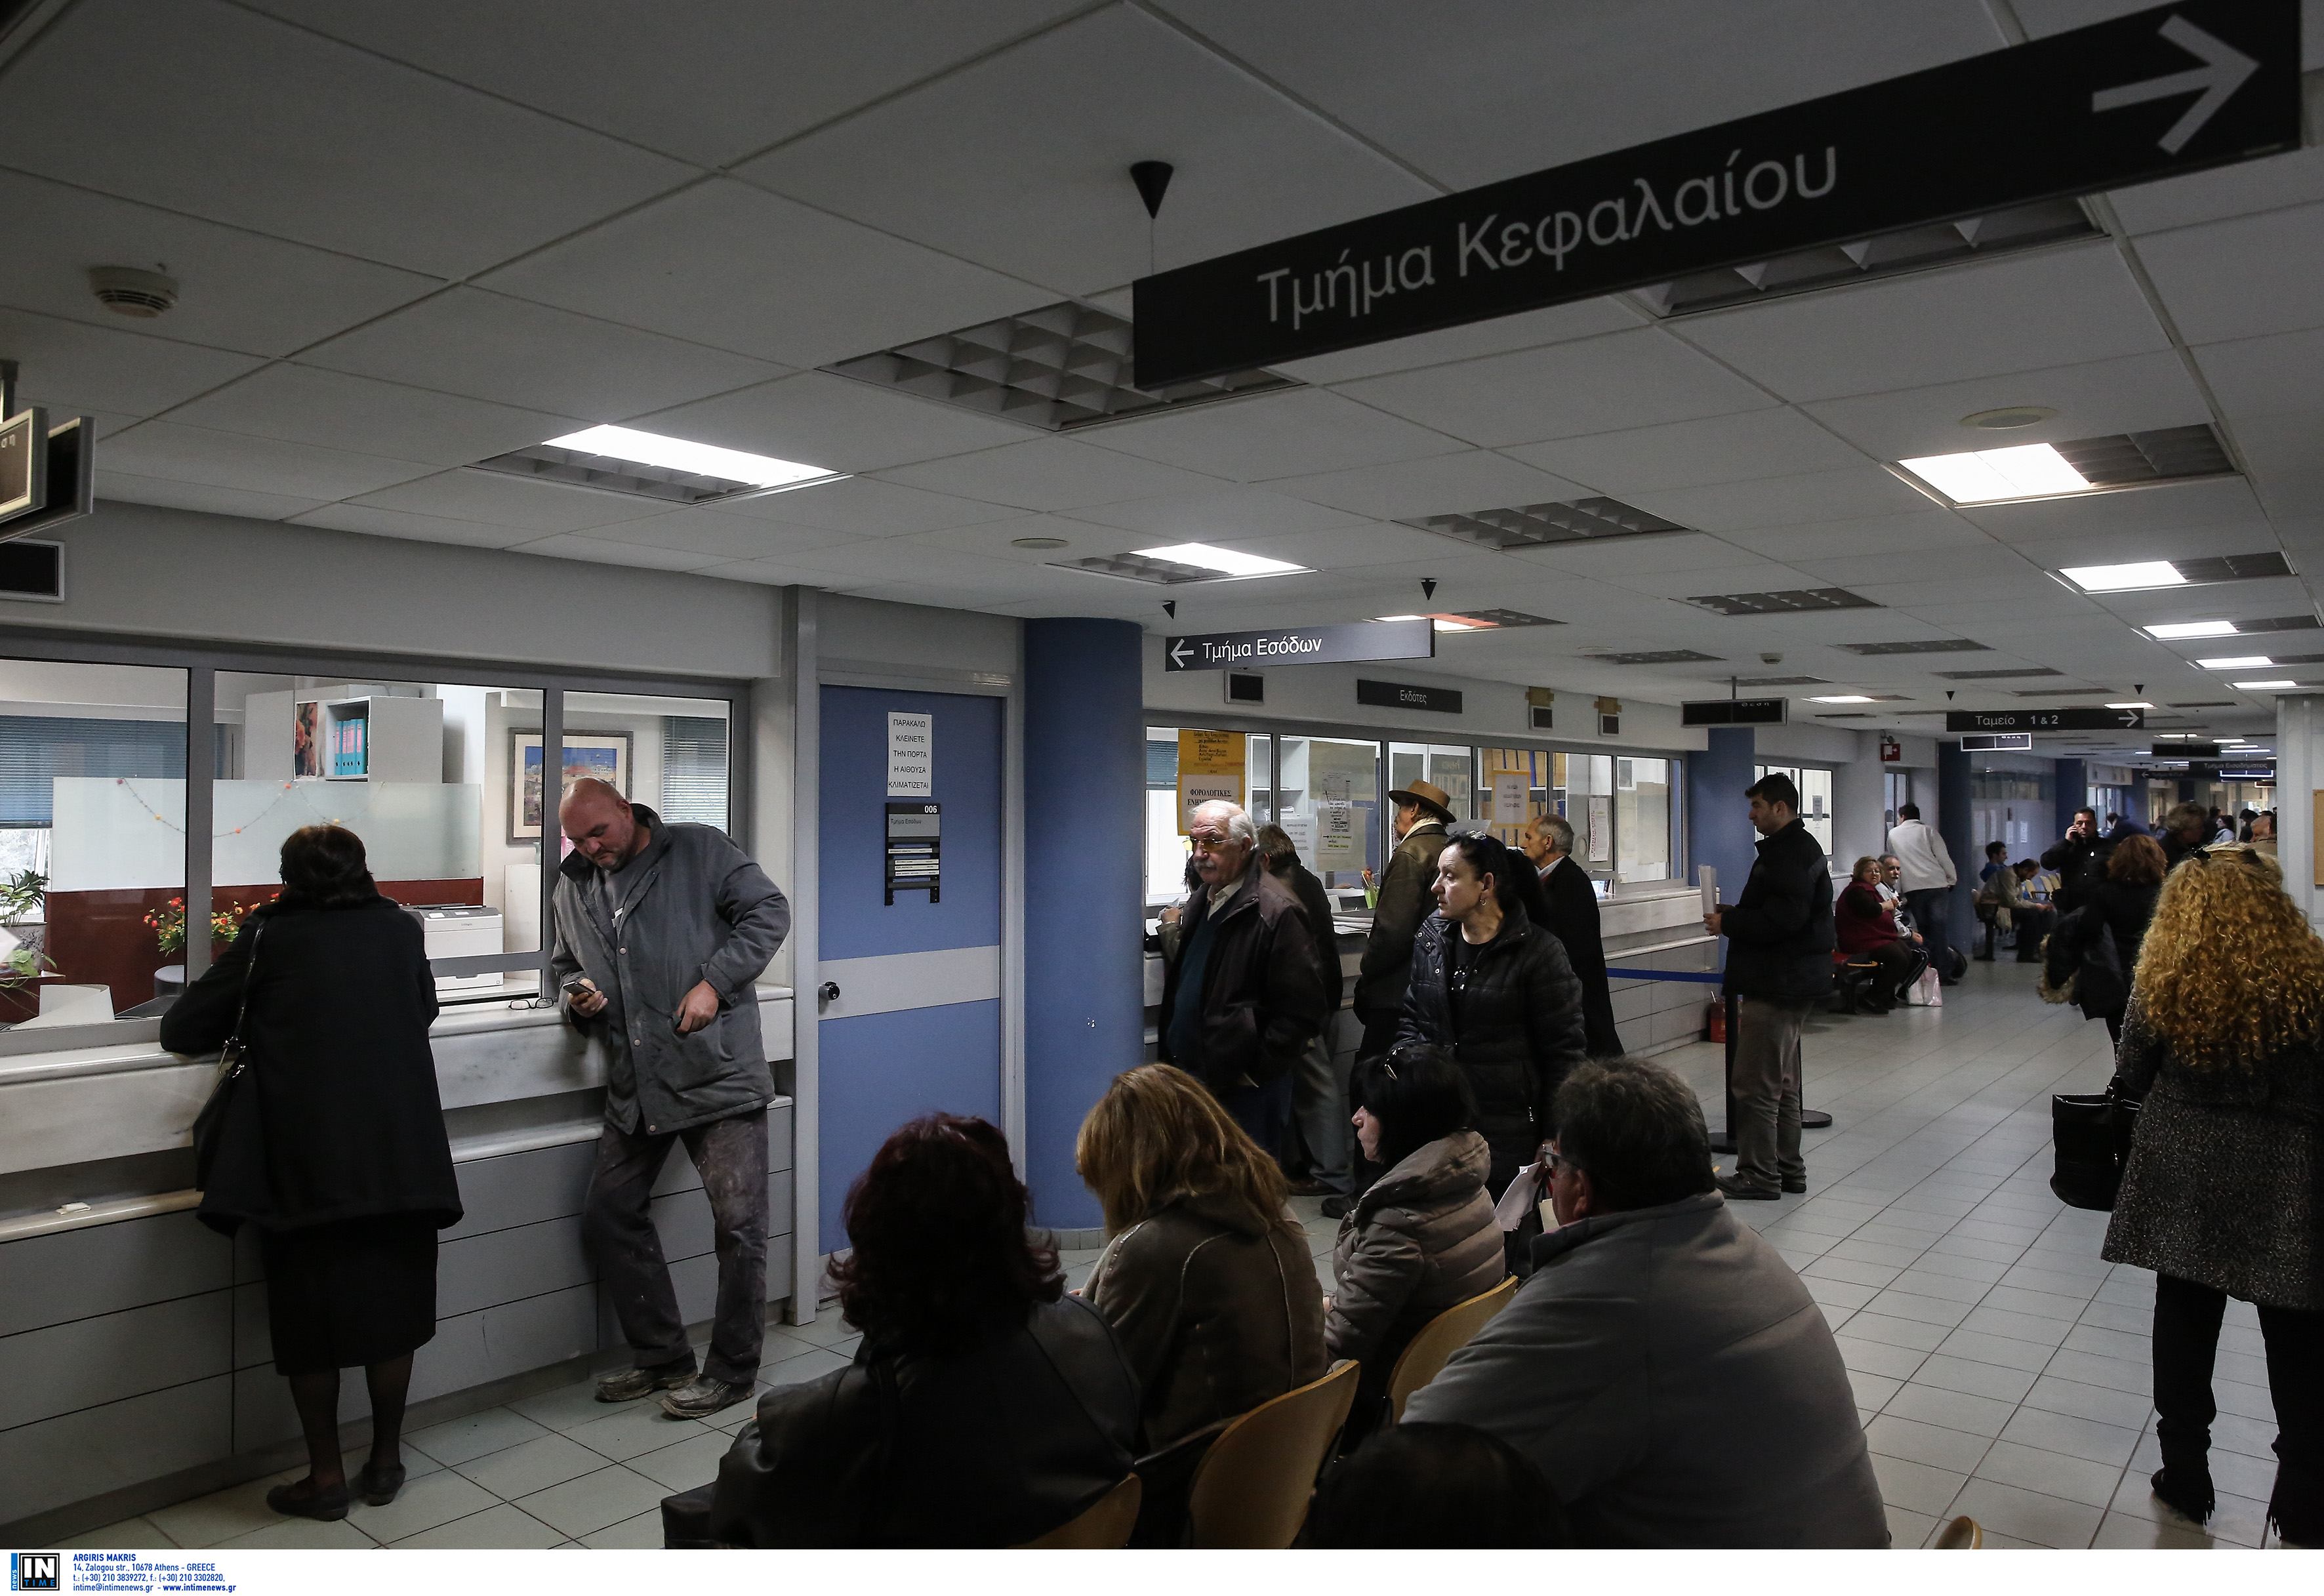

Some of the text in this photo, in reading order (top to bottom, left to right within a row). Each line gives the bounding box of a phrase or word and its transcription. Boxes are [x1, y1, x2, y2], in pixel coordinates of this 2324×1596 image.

[1257, 147, 1836, 330] Τμήμα Κεφαλαίου
[1202, 636, 1322, 663] Τμήμα Εσόδων
[1400, 689, 1427, 705] Εκδότες
[893, 719, 926, 728] ΠΑΡΑΚΑΛΩ
[1975, 714, 2058, 727] Ταμείο 1 & 2
[896, 735, 925, 743] ΚΛΕΙΝΕΤΕ
[1190, 788, 1232, 797] ΦΟΡΟΛΟΓΙΚΕΣ
[924, 805, 937, 813] 006
